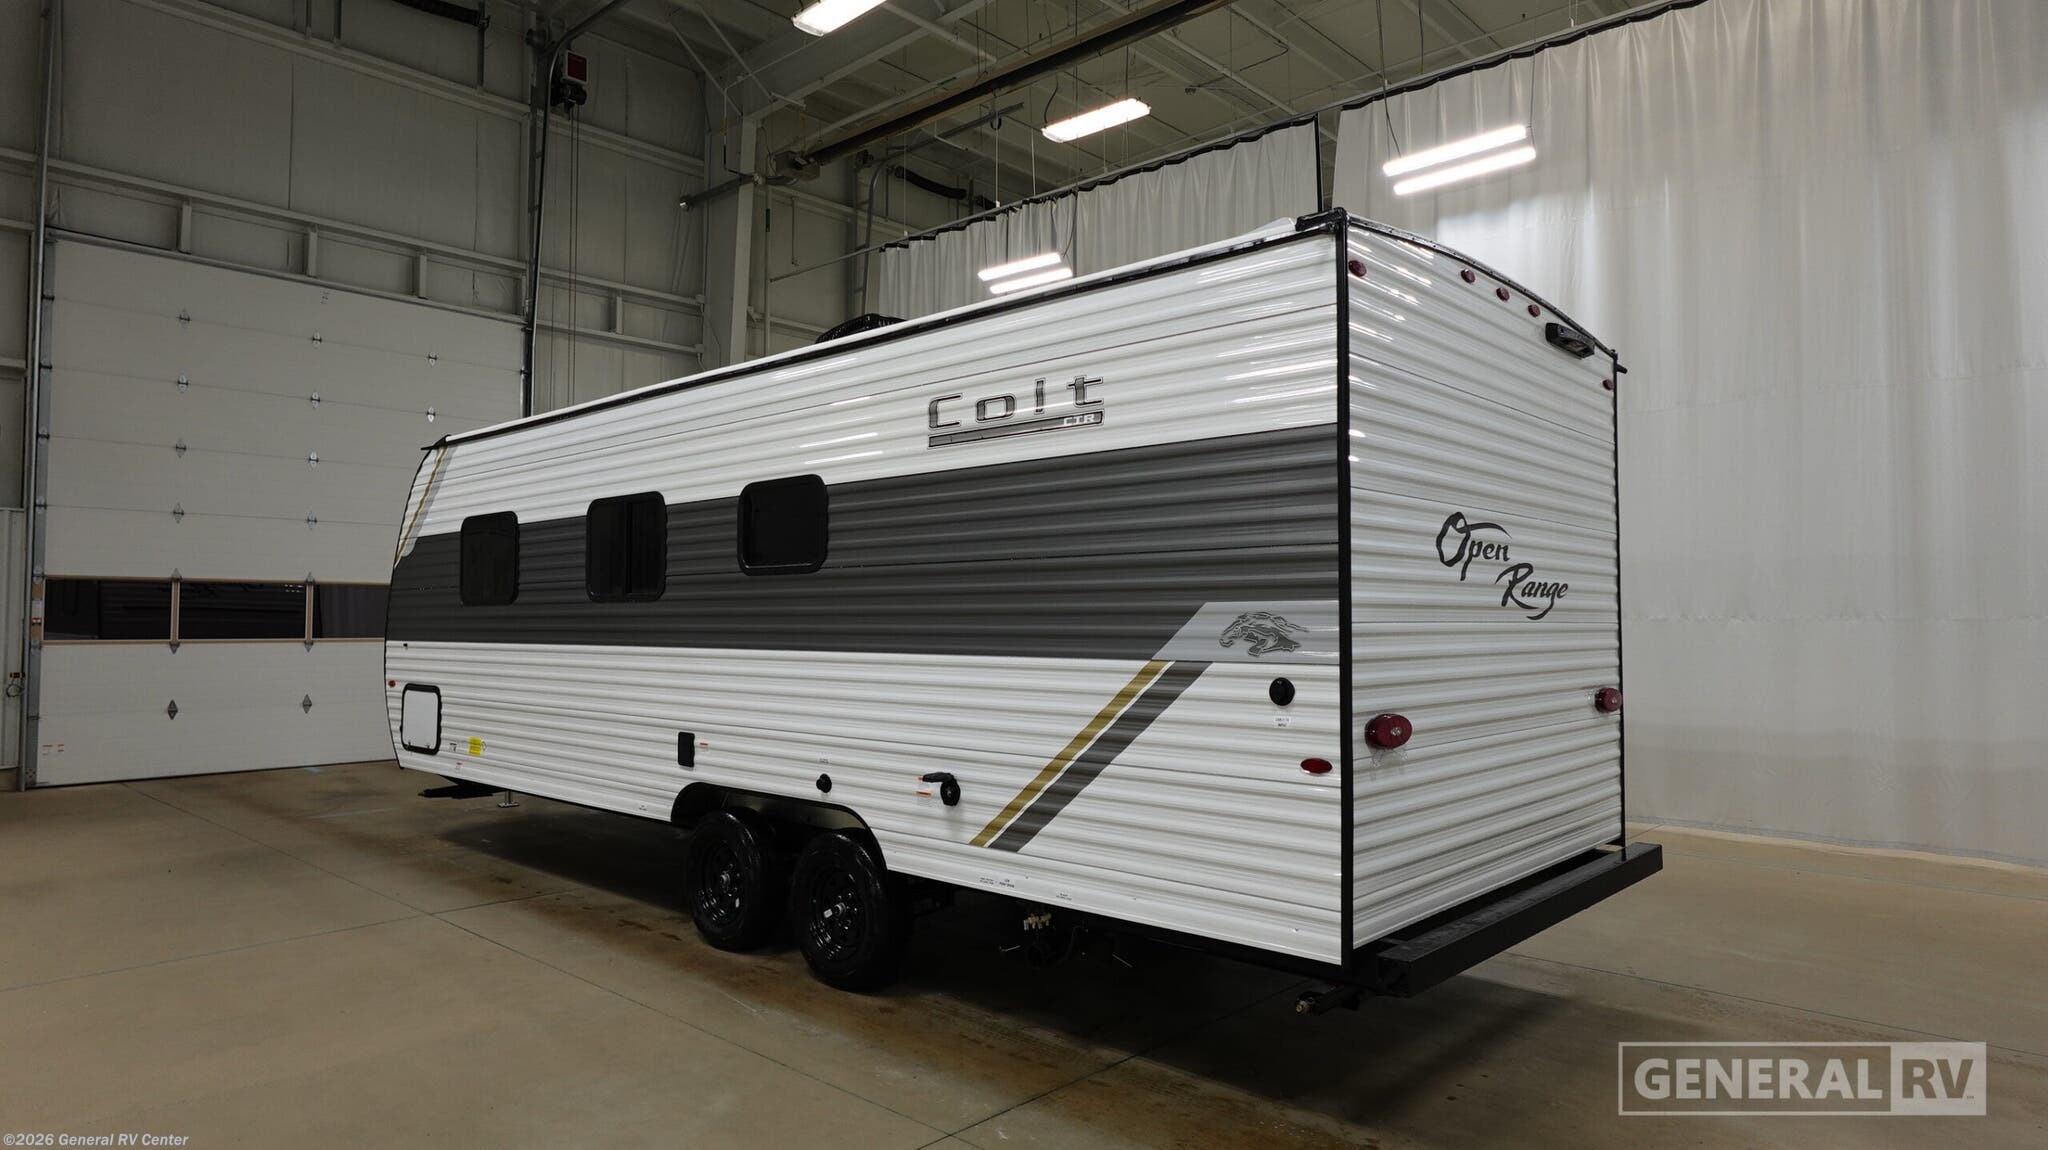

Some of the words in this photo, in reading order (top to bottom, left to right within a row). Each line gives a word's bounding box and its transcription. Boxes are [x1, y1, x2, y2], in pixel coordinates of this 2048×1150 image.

[928, 375, 1103, 430] Colt
[1436, 512, 1512, 581] Open
[1495, 563, 1568, 620] Range
